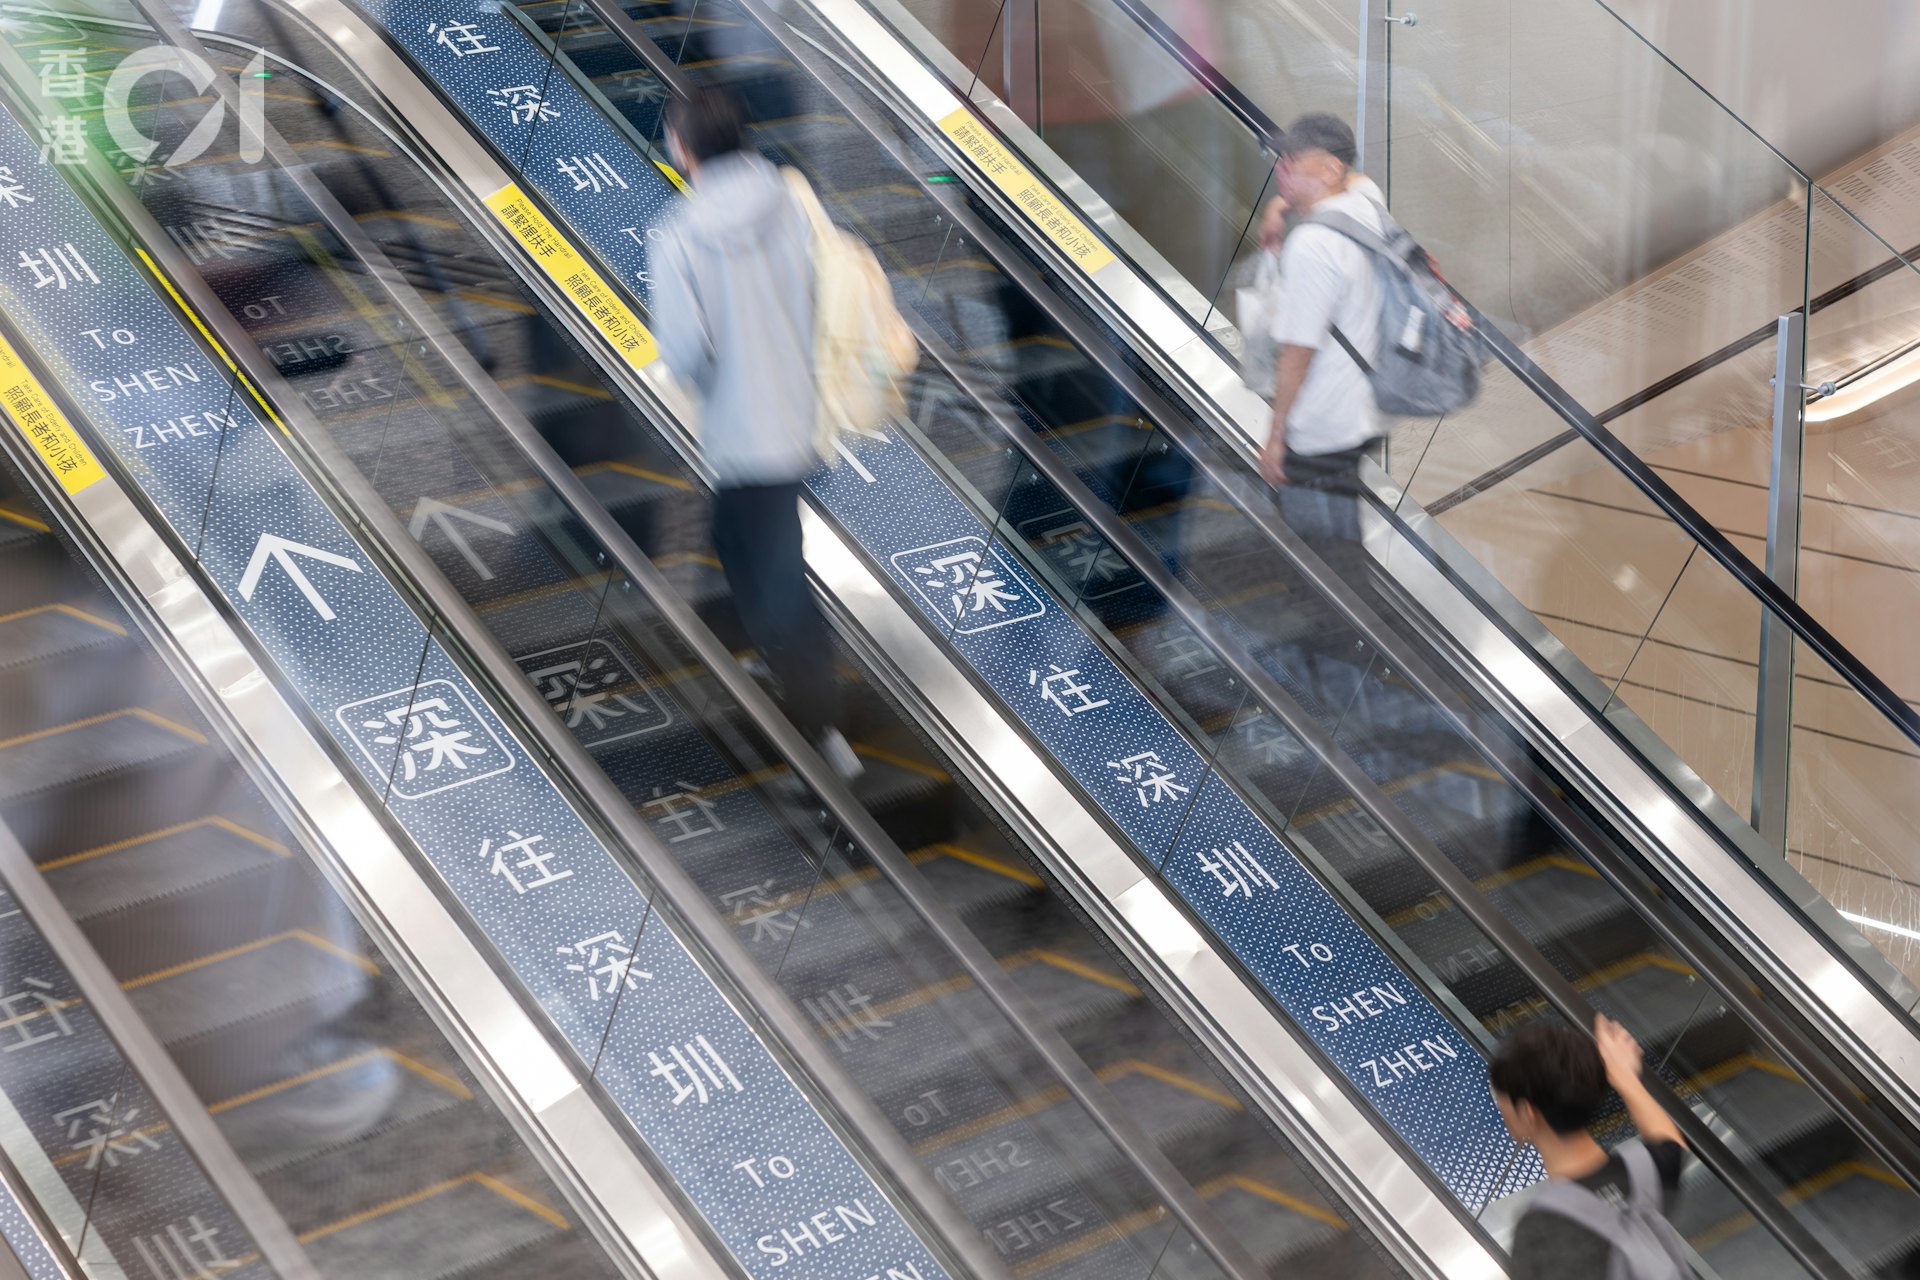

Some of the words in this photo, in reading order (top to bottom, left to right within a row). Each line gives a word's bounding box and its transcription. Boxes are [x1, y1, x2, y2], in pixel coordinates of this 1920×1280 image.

[427, 19, 629, 194] 往深圳
[952, 125, 1007, 175] 請緊握扶手
[966, 121, 981, 137] Please
[981, 135, 994, 148] Hold
[1001, 152, 1023, 176] Handrail
[500, 203, 557, 258] 請緊握扶手
[516, 198, 532, 216] Please
[531, 215, 544, 229] Hold
[551, 235, 573, 260] Handrail
[1017, 188, 1091, 259] 照顧長者和小孩
[1029, 184, 1042, 197] Take
[1040, 193, 1053, 206] Care
[1056, 209, 1072, 225] Elderly
[1079, 230, 1099, 252] Children
[564, 273, 640, 353] 照顧長者和小孩
[578, 268, 591, 283] Take
[589, 280, 602, 294] Care
[606, 297, 621, 316] Elderly
[628, 321, 648, 345] Children
[90, 362, 201, 403] SHEN
[3, 385, 78, 475] 照顧長者和小孩
[22, 379, 33, 393] Take
[31, 393, 43, 407] Care
[45, 413, 62, 433] Elderly
[69, 442, 88, 467] Children
[123, 407, 239, 450] ZHEN
[915, 550, 1020, 619] 深
[363, 696, 488, 781] 深
[1028, 663, 1280, 898] 往深圳
[478, 829, 744, 1106] 往深圳
[1312, 980, 1408, 1033] SHEN
[1359, 1034, 1458, 1090] ZHEN
[756, 1198, 877, 1268] SHEN
